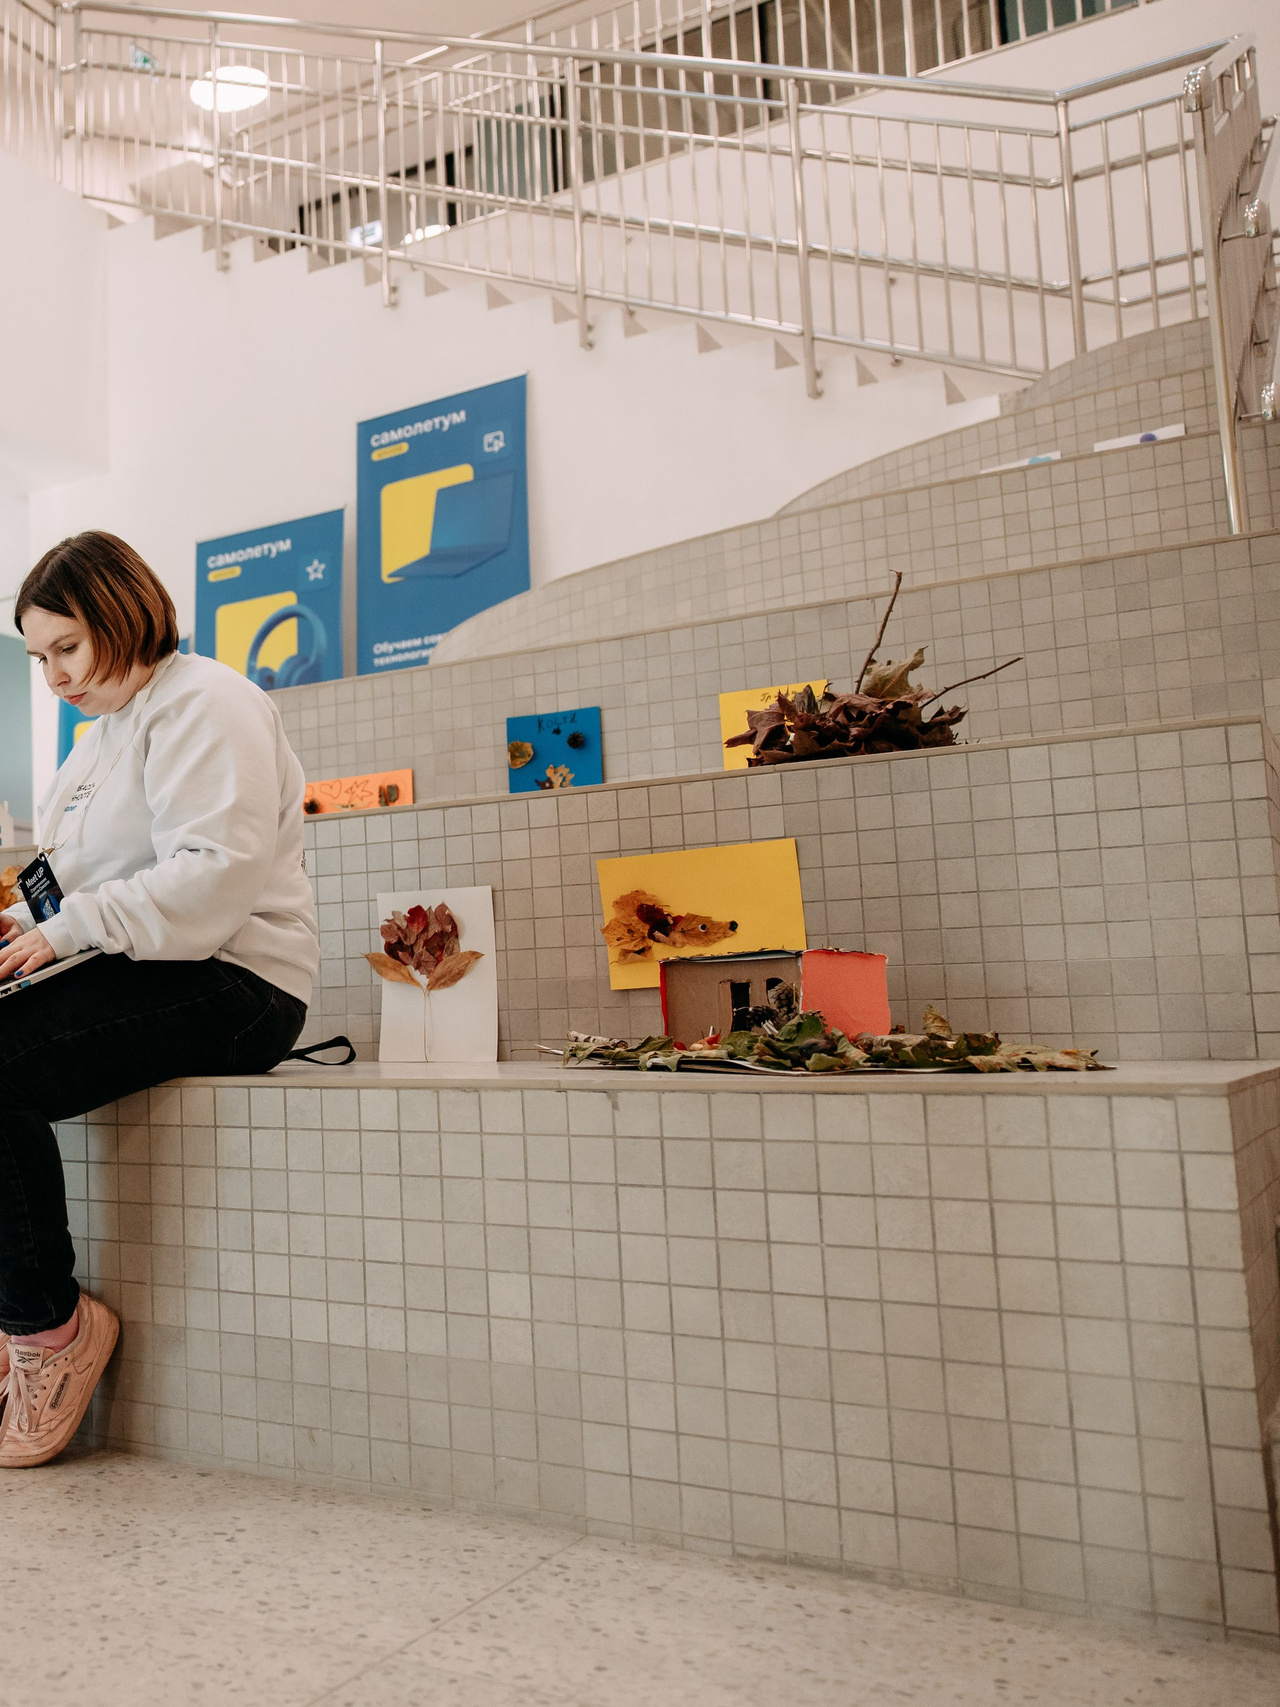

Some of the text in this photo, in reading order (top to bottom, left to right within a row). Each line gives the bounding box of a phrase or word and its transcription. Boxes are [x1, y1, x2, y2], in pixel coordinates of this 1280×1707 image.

[370, 409, 467, 448] самолетум
[207, 537, 292, 569] самолетум
[373, 632, 446, 655] Обучаем сов
[25, 873, 39, 889] Meet
[36, 866, 45, 878] UP
[14, 1348, 41, 1358] Reebok
[51, 1381, 66, 1409] Reebok
